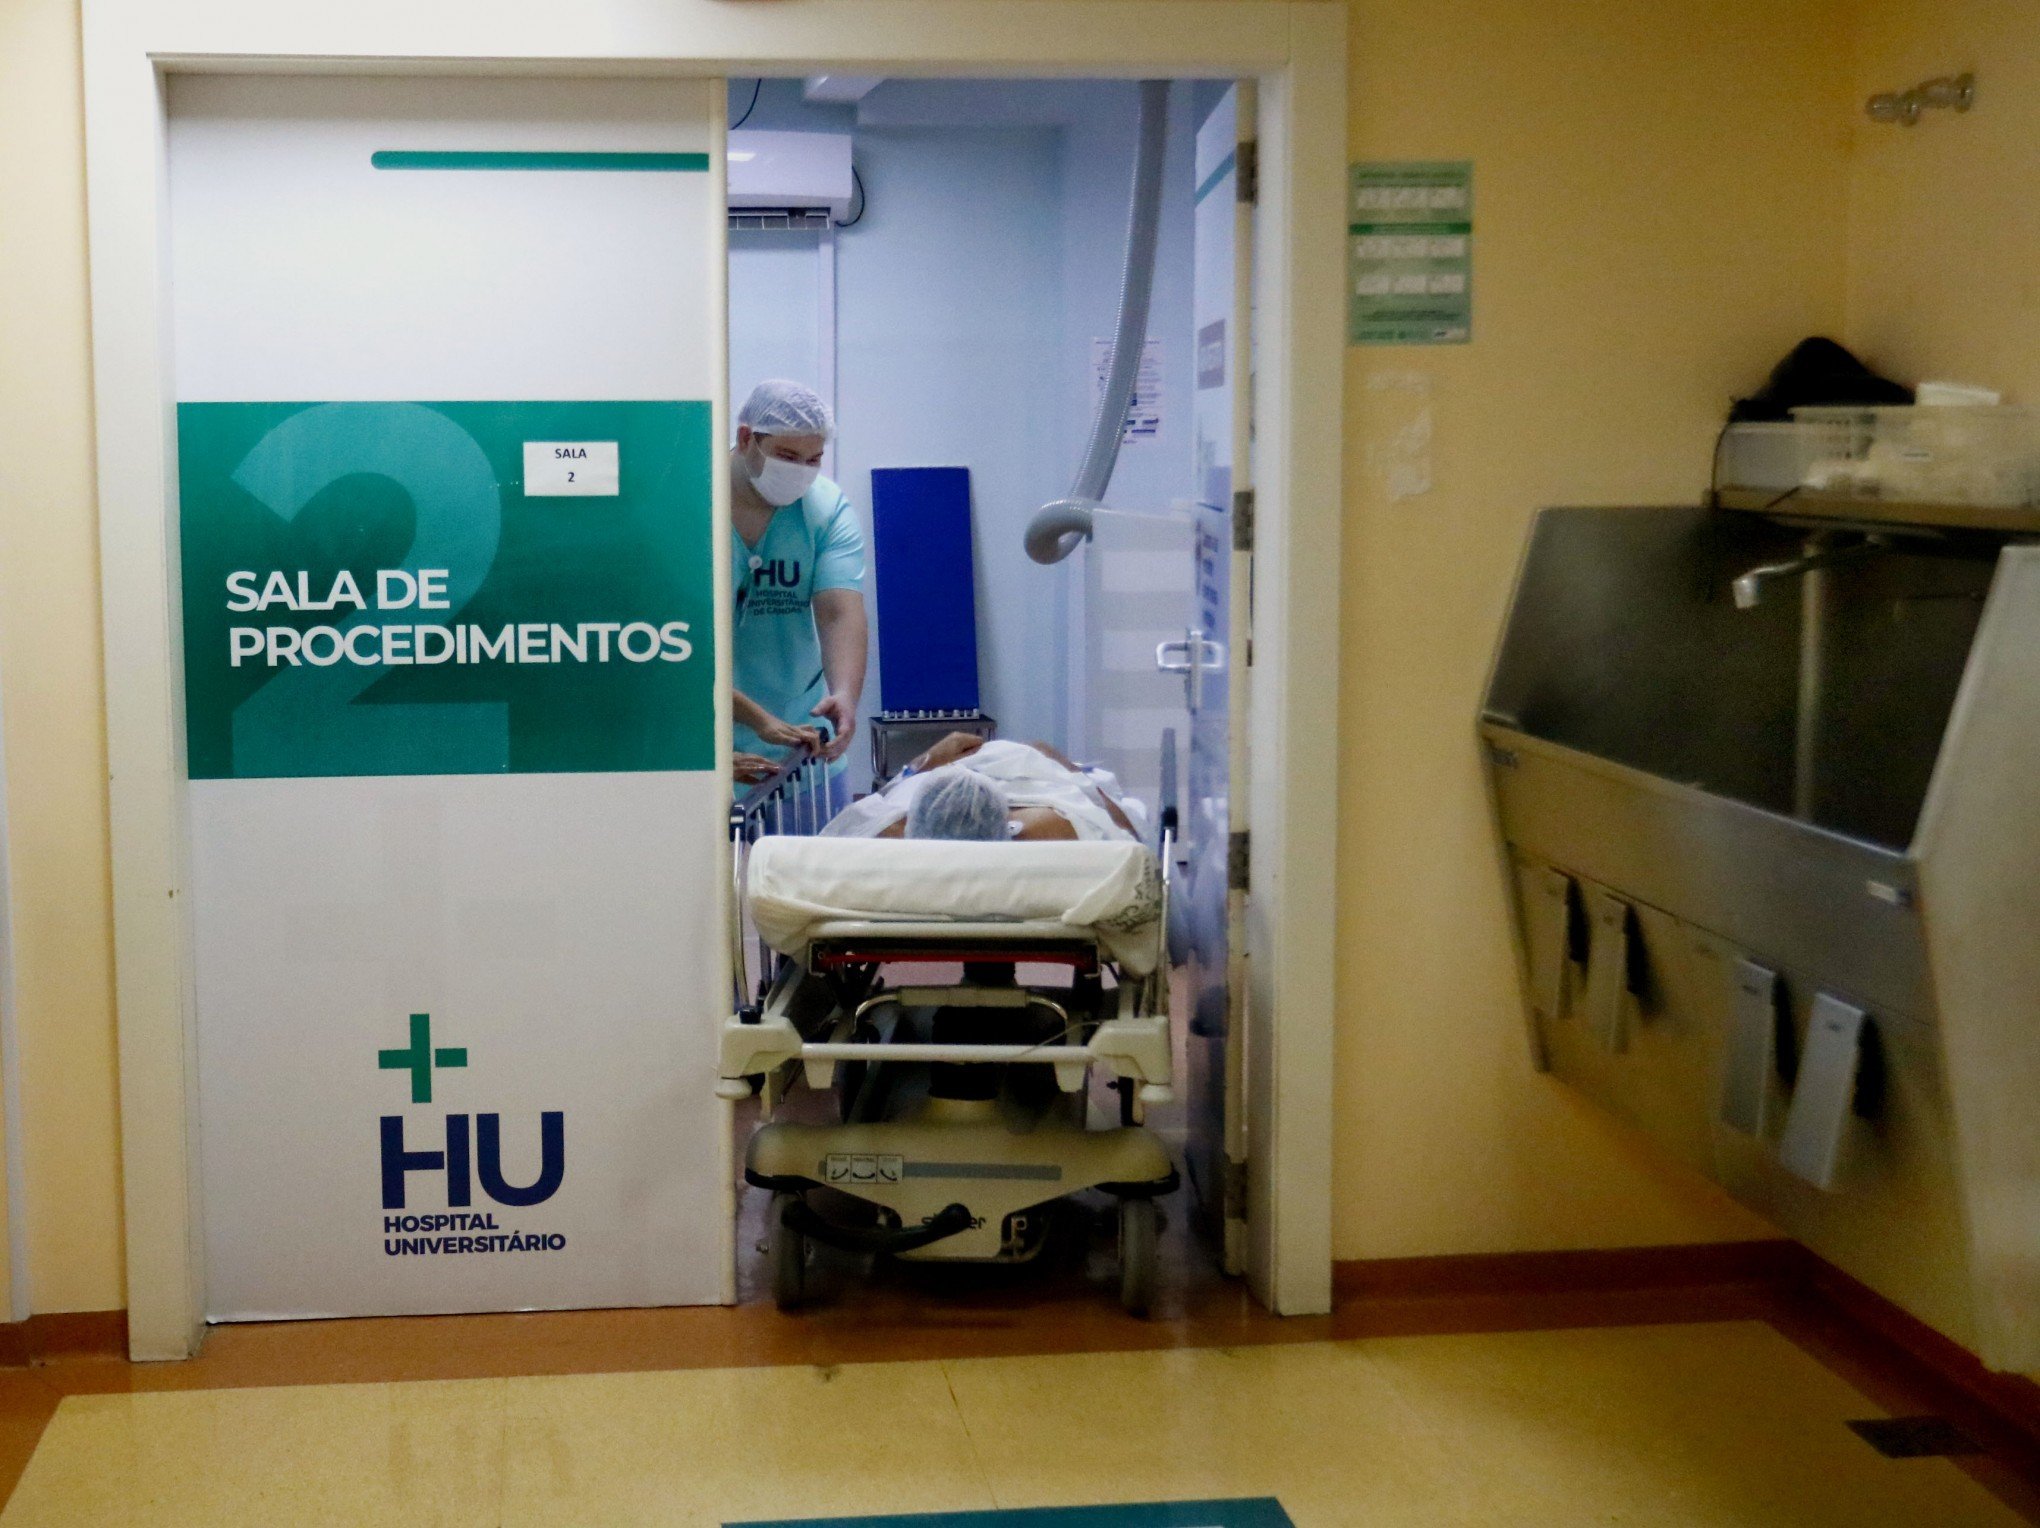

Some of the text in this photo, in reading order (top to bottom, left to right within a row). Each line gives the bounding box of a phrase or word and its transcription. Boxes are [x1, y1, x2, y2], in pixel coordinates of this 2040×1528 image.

[554, 448, 587, 459] SALA
[567, 471, 576, 483] 2
[753, 559, 800, 588] HU
[226, 569, 451, 612] SALA DE
[230, 400, 510, 779] 2
[229, 621, 692, 667] PROCEDIMENTOS
[380, 1111, 565, 1209] HU
[384, 1213, 499, 1233] HOSPITAL
[384, 1230, 566, 1256] UNIVERSITÁRIO
